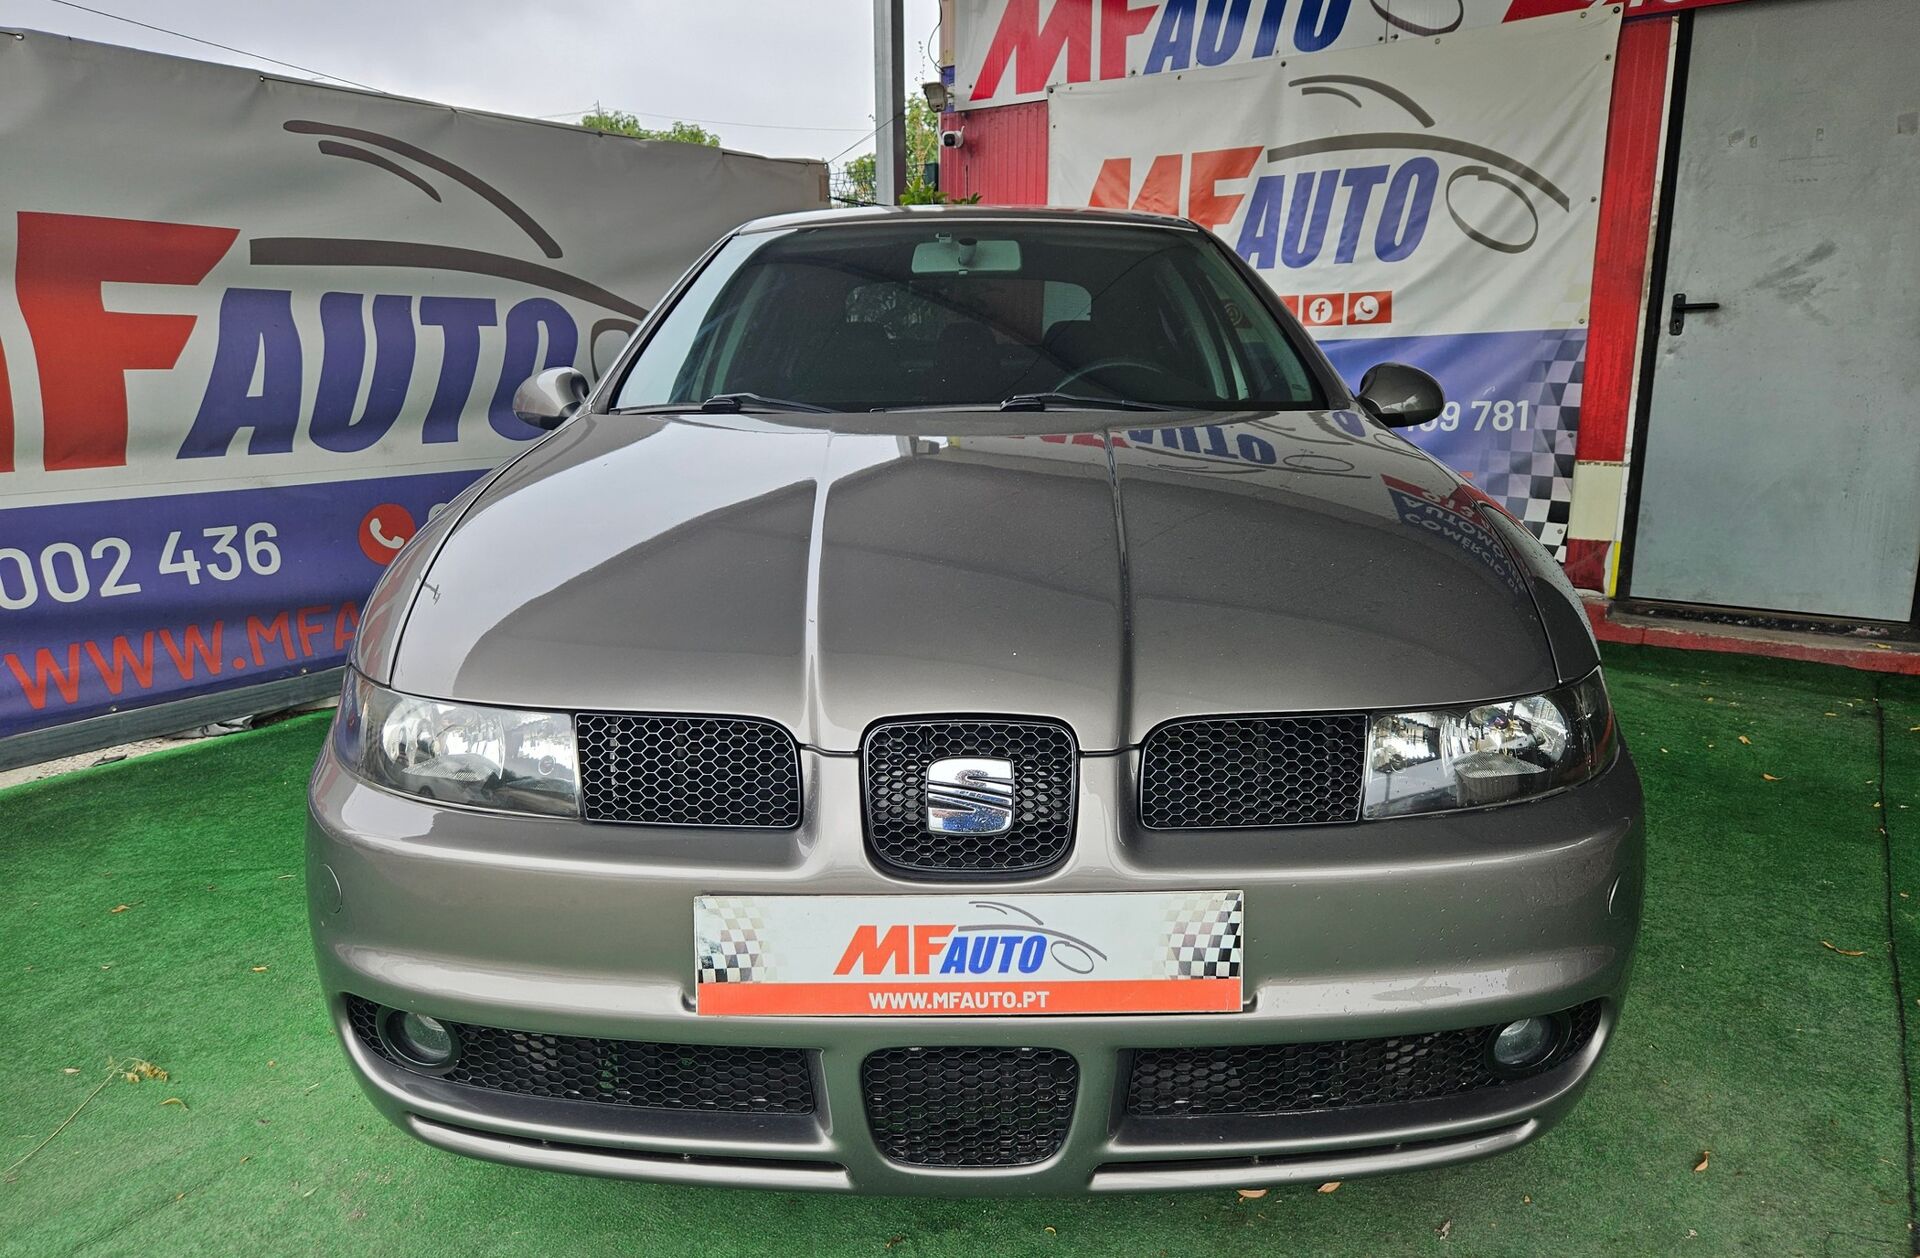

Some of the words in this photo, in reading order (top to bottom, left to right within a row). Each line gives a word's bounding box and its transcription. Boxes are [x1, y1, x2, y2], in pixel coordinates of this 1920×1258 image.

[0, 211, 578, 473] FAUTO
[1471, 400, 1529, 432] 781
[0, 537, 141, 610] 002
[159, 522, 281, 585] 436
[869, 991, 1049, 1009] WWW.MFAUTO.PT
